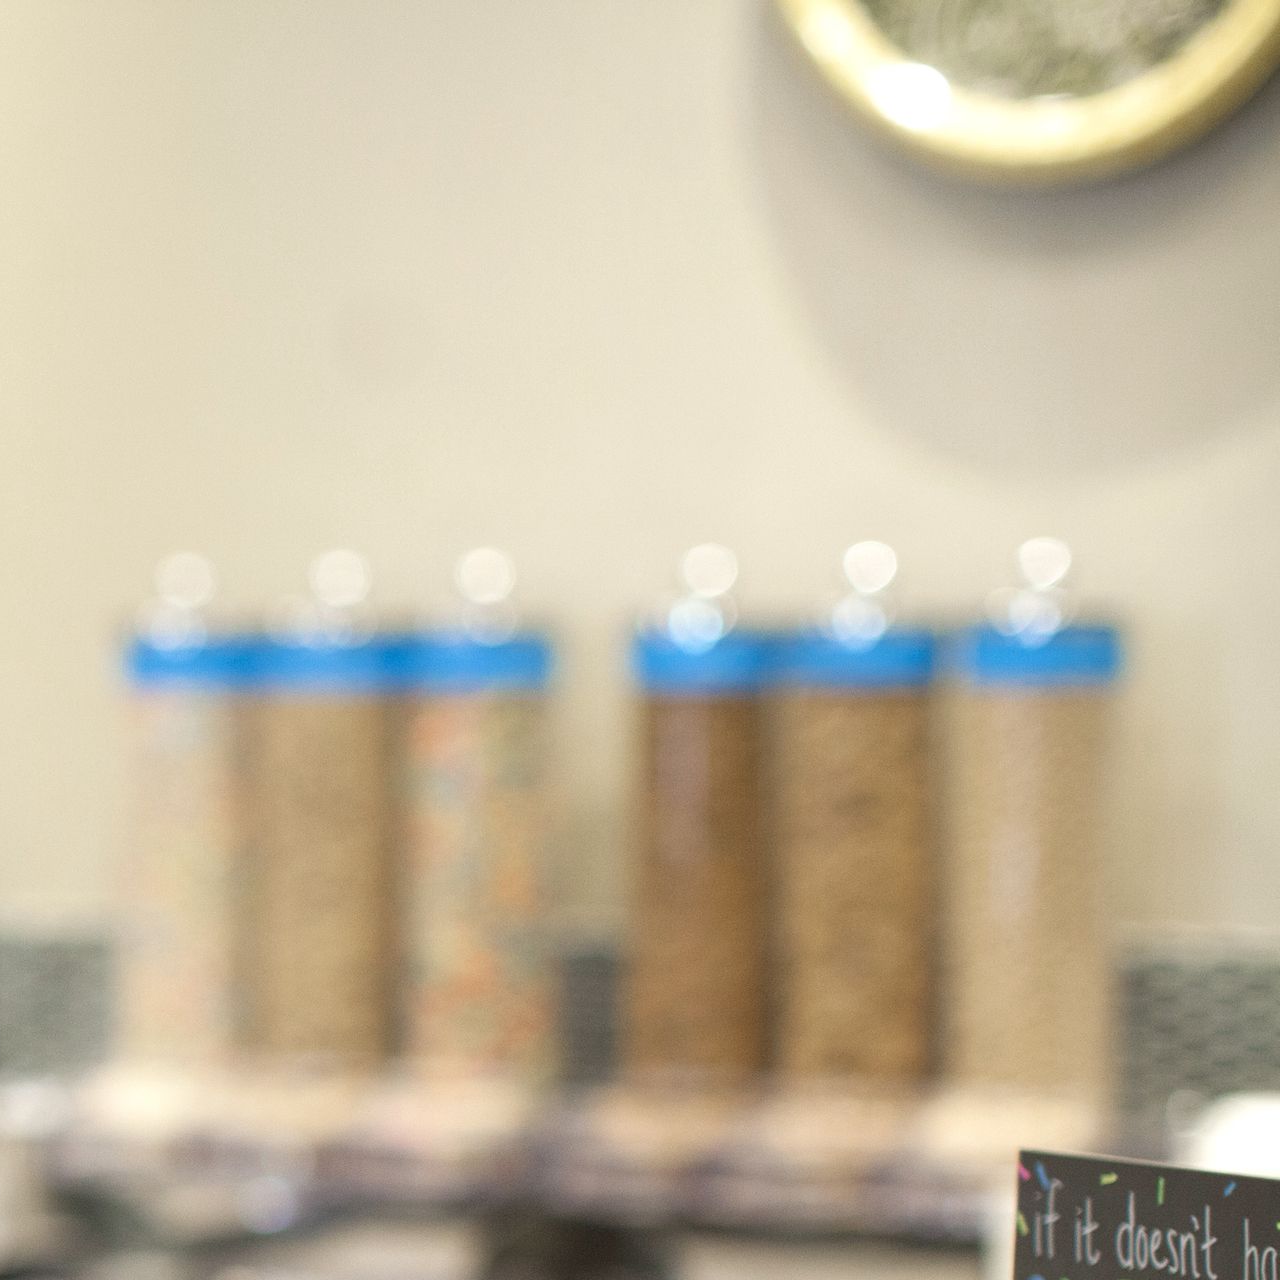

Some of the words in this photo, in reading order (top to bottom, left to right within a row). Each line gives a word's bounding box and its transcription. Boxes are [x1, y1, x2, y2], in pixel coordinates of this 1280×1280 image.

[1034, 1178, 1063, 1259] if
[1074, 1197, 1101, 1266] it
[1116, 1191, 1218, 1280] doesn't
